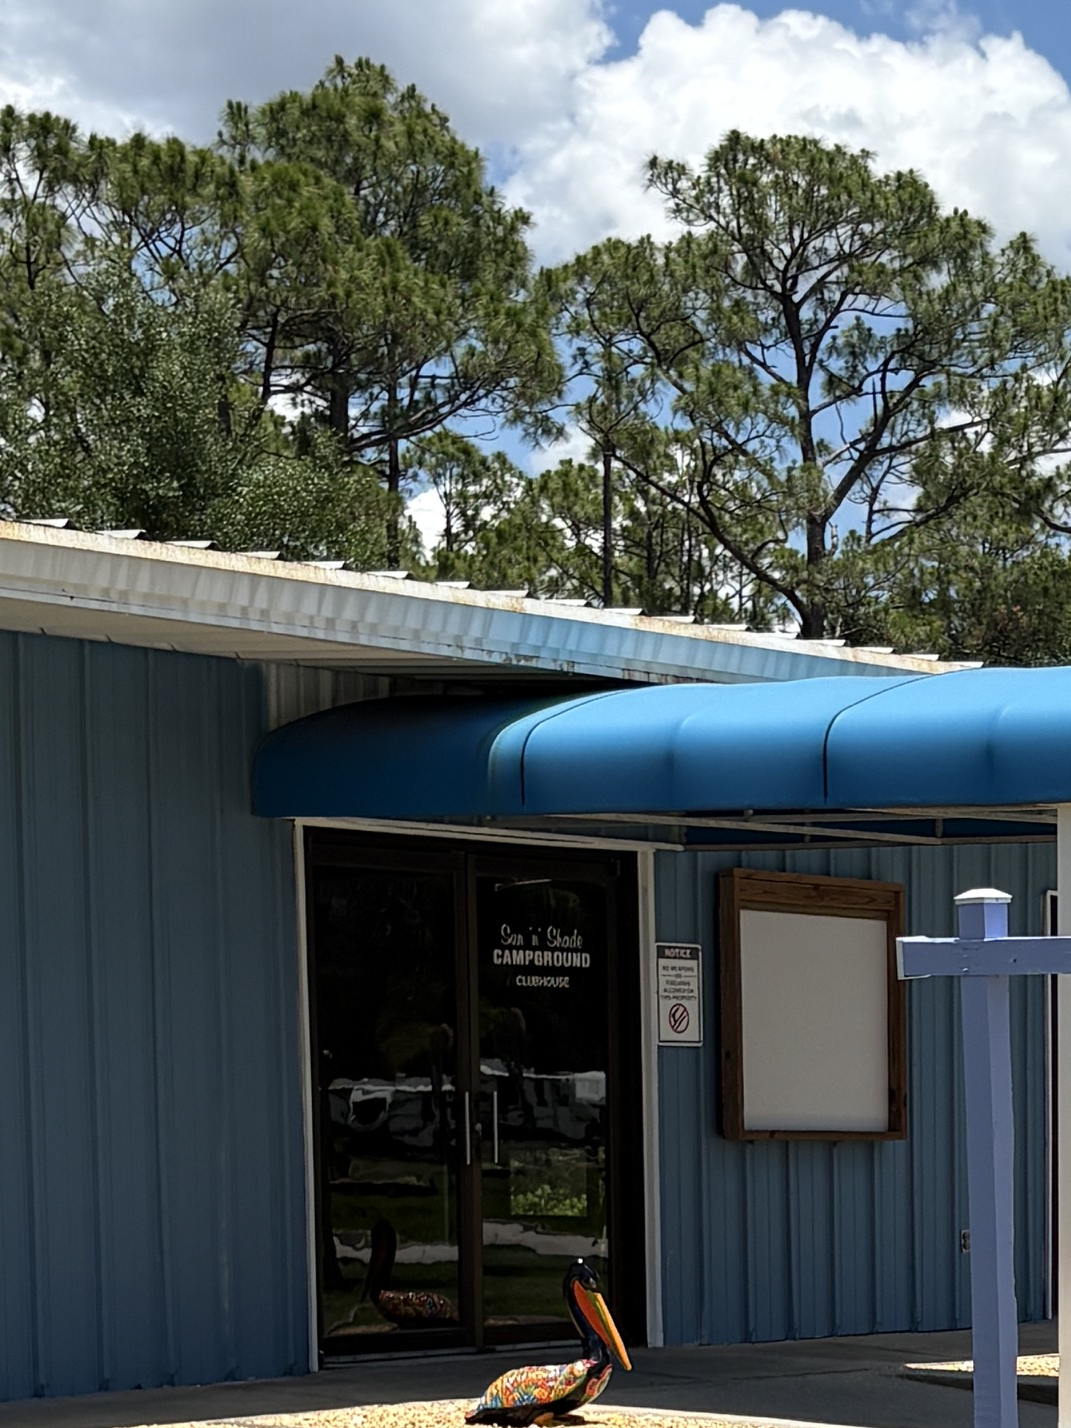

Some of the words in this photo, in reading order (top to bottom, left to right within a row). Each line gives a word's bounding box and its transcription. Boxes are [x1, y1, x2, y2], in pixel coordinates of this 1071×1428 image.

[547, 925, 584, 949] Shade
[493, 949, 591, 968] CAMPGROUND
[664, 948, 692, 958] NOTICE
[516, 975, 570, 988] CLUBHOUSE
